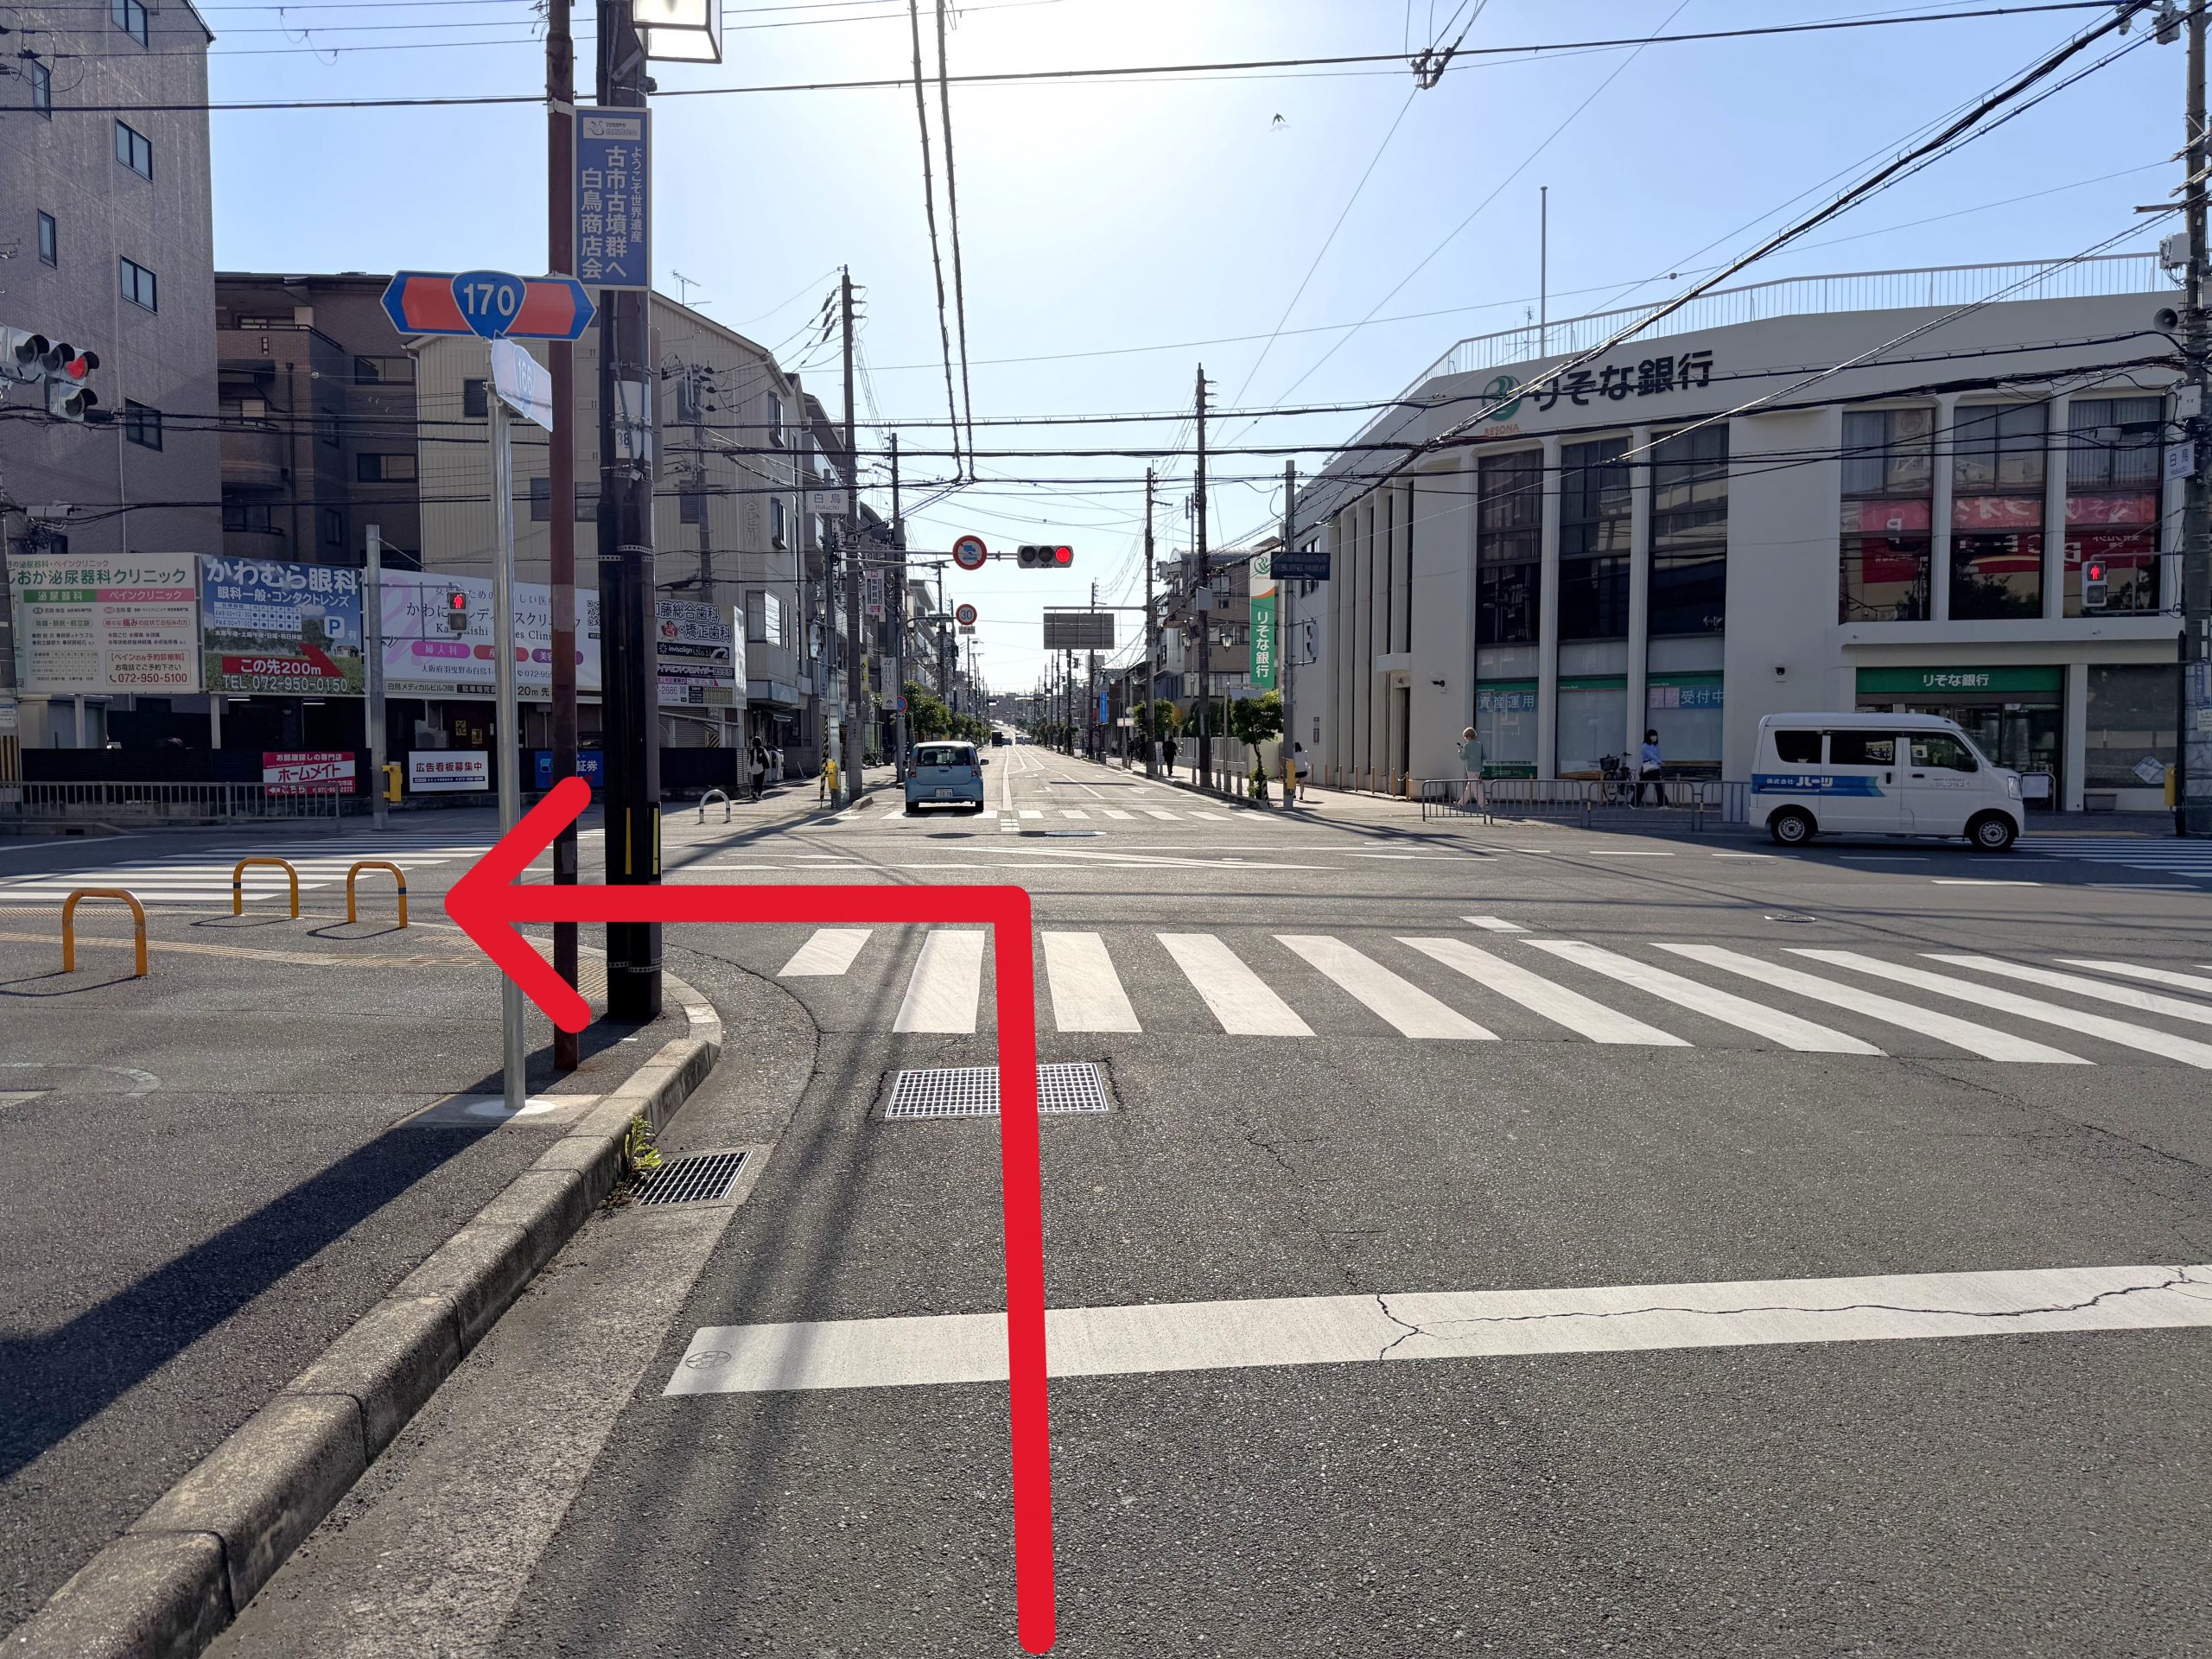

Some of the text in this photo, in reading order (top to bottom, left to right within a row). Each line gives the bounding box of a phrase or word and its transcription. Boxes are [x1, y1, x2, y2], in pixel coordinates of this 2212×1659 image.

[630, 145, 643, 243] ようこそ世界遺産
[605, 146, 627, 278] 古市古墳群へ
[581, 168, 603, 279] 白鳥商店会
[462, 283, 516, 317] 170
[518, 357, 533, 397] 166
[1534, 350, 1713, 412] りそな銀行
[814, 492, 841, 504] 白鳥
[207, 557, 359, 595] かわむら眼科
[37, 590, 182, 601] 泌尿器科 ペインクリニック
[217, 586, 350, 607] 眼科一般・コンタクトレンズ
[960, 609, 973, 620] 30
[328, 619, 357, 640] P 有
[436, 623, 488, 636] Kaishi
[425, 644, 458, 656] 婦人科
[668, 645, 693, 655] invisalign
[1255, 611, 1269, 678] りそな銀行
[240, 658, 322, 676] この先200m
[118, 673, 188, 683] 072-950-5100
[222, 675, 348, 692] TEL 072-950-0150
[1922, 674, 1990, 687] りそな銀行
[387, 682, 454, 692] 白鳥メディカルビル3階
[541, 687, 550, 696] 先
[1478, 694, 1535, 709] 資産運用
[276, 753, 343, 762] お部屋探しの専門店
[278, 763, 341, 782] ホームメイト
[416, 761, 483, 772] 広告看板募集中
[1796, 776, 1834, 787] ハーツ
